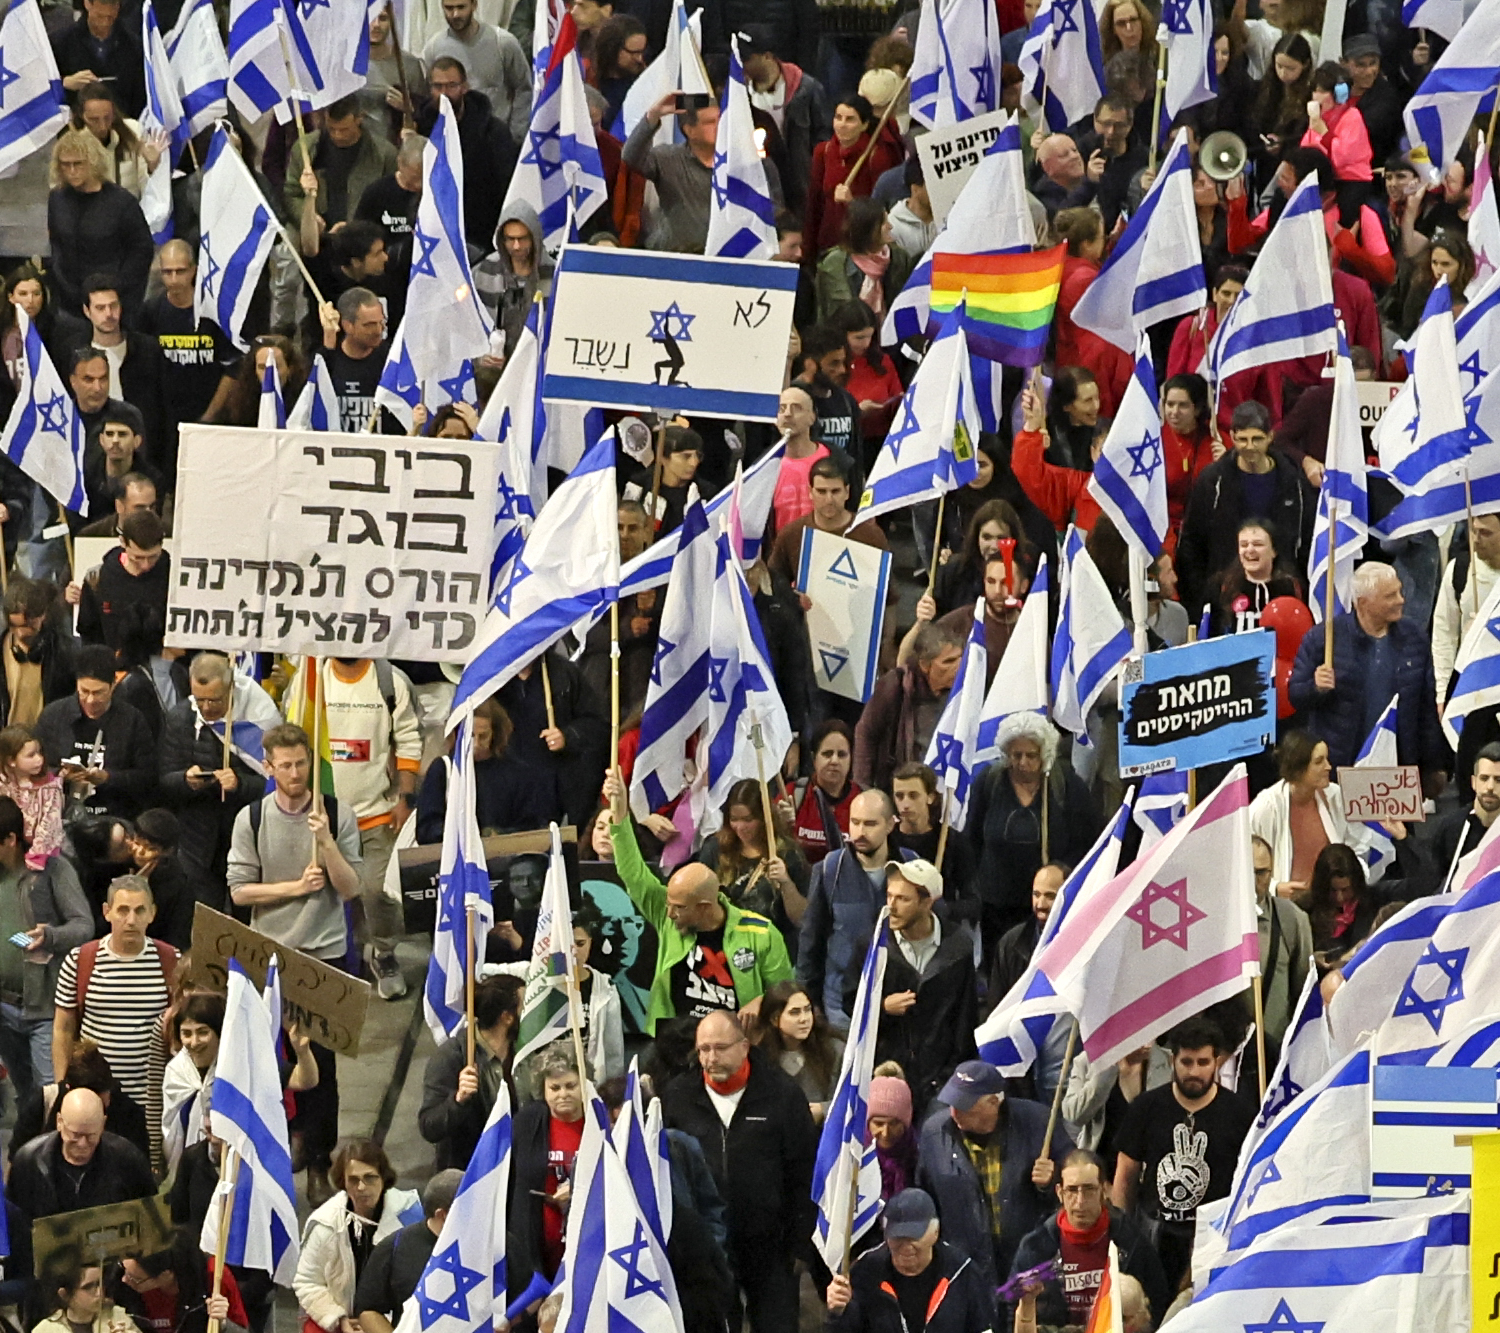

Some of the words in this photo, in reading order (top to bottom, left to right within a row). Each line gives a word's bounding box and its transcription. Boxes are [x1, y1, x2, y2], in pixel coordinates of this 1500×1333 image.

[303, 446, 476, 501] ביבי
[301, 504, 471, 555] בוגד
[364, 566, 482, 608] הורס
[272, 596, 392, 643] להציל
[401, 609, 477, 652] כדי
[1157, 672, 1233, 711] מחאת
[1136, 697, 1254, 742] ההייטקיסטים
